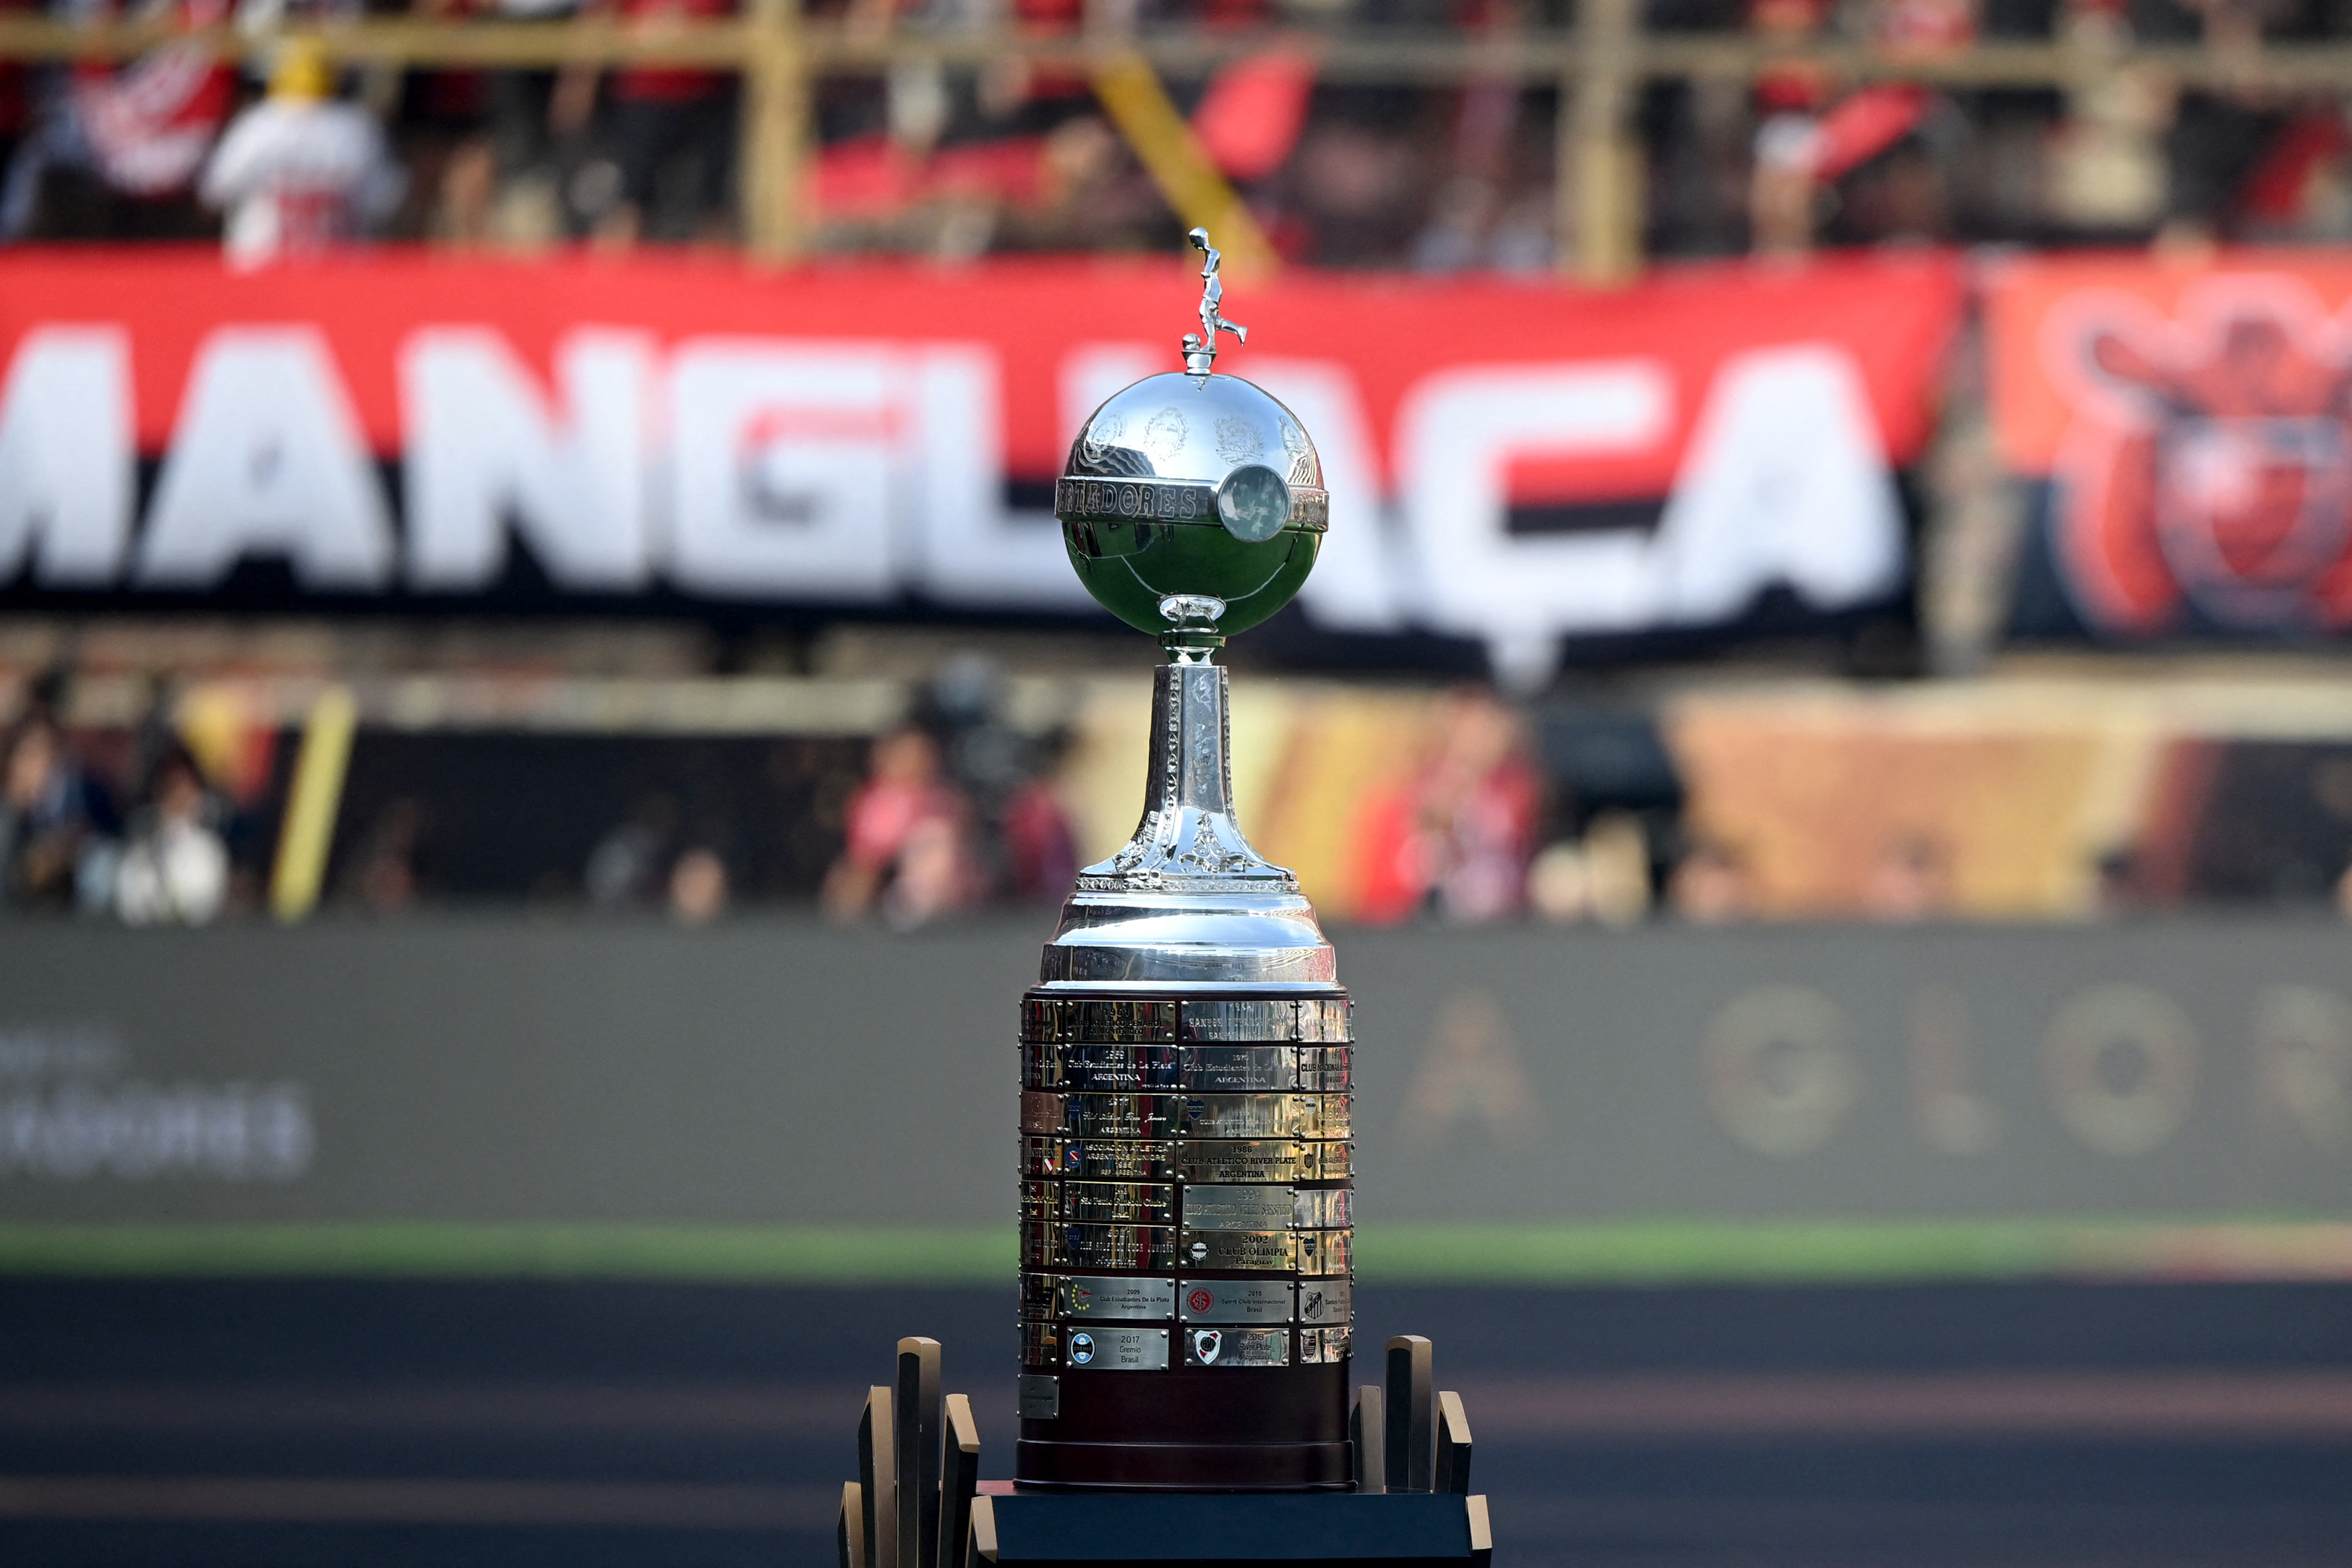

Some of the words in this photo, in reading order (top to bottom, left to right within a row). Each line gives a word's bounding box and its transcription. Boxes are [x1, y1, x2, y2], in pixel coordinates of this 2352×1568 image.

[1301, 1063, 1317, 1072] CLUB
[1242, 1235, 1268, 1243] 2002
[1218, 1248, 1246, 1256] CLUB
[1249, 1247, 1288, 1256] OLIMPIA
[1235, 1257, 1274, 1266] Paraguay
